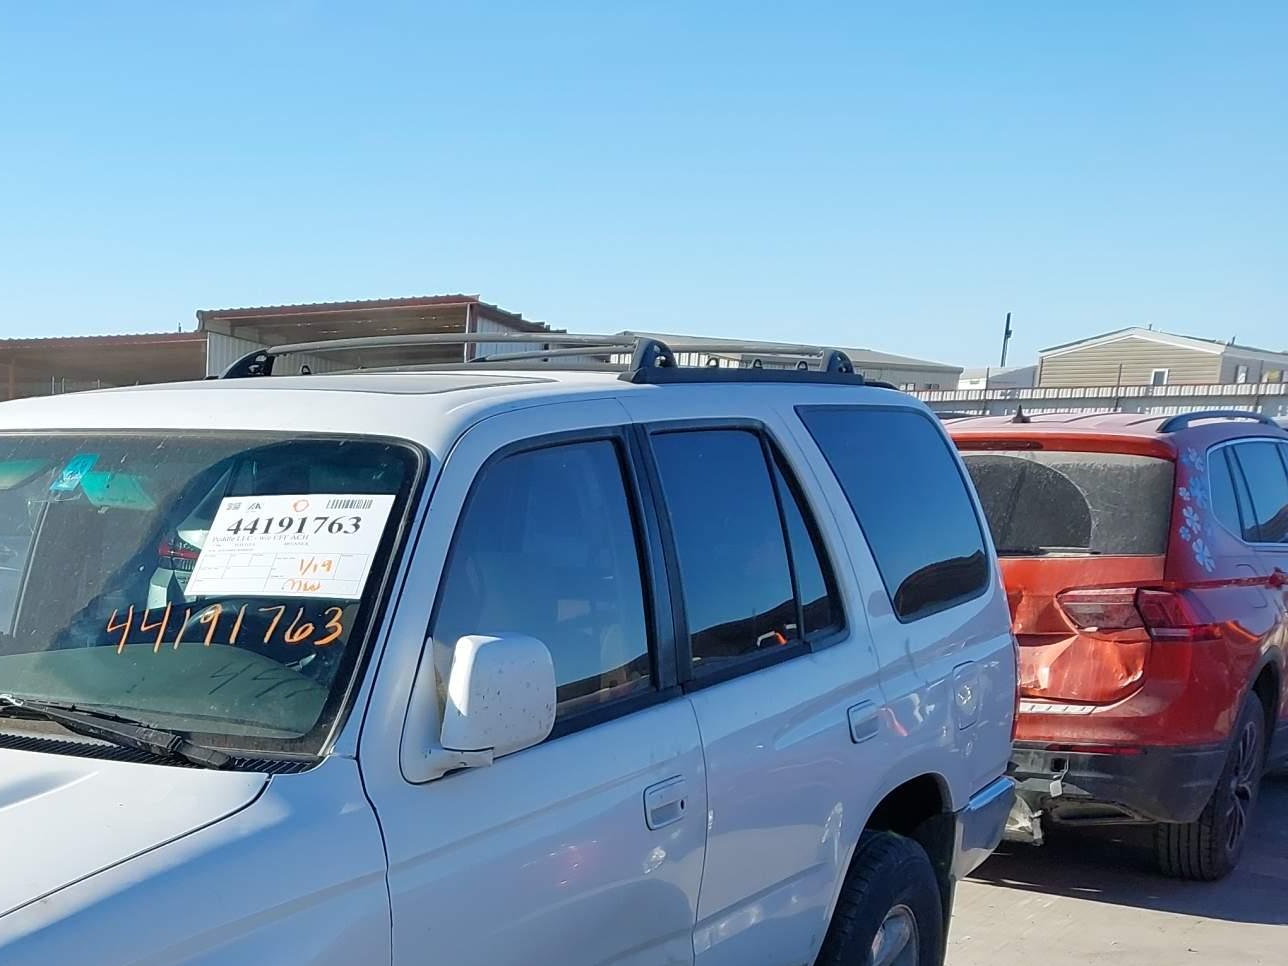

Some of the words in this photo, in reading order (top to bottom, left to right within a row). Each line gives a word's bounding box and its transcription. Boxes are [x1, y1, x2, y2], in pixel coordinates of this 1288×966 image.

[227, 516, 363, 535] 44191763
[299, 556, 333, 576] 1/19
[106, 601, 344, 655] 44191763
